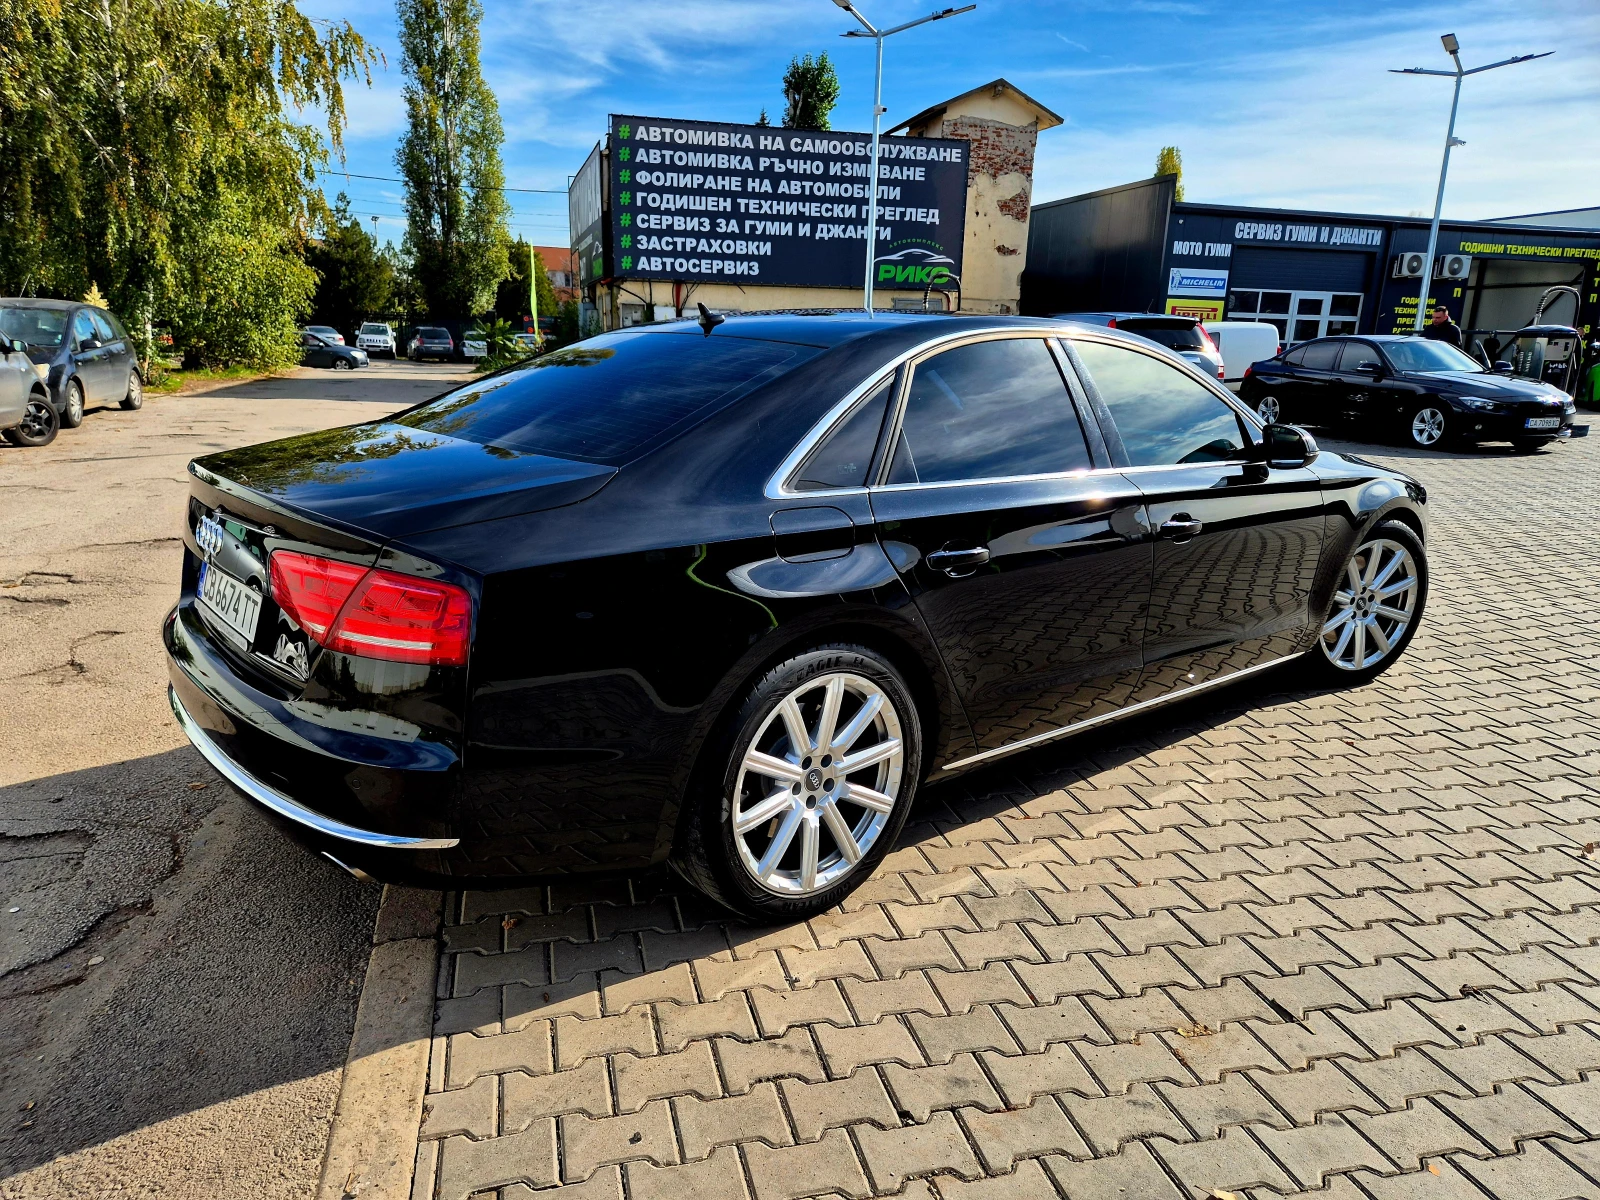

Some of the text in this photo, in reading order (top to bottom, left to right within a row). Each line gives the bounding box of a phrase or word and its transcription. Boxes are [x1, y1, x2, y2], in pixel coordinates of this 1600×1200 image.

[635, 125, 754, 149] АВТОМИВКА
[759, 135, 785, 151] НА
[635, 148, 754, 171] АВТОМИВКА
[759, 158, 825, 175] РЪЧНО
[635, 171, 742, 192] ФОЛИРАНЕ
[747, 178, 773, 194] НА
[636, 192, 732, 212] ГОДИШЕН
[737, 199, 857, 219] ТЕХНИЧЕСКИ
[636, 213, 711, 232] СЕРВИЗ
[716, 218, 740, 234] ЗА
[744, 219, 793, 237] ГУМИ
[798, 222, 811, 237] И
[1234, 221, 1383, 246] СЕРВИЗ ГУМИ И ДЖАНТИ
[636, 235, 772, 256] ЗАСТРАХОВКИ
[1173, 241, 1232, 258] МОТО ГУМИ
[1460, 241, 1505, 254] ГОДИШНИ
[1506, 245, 1562, 257] ТЕХНИЧЕСКИ
[637, 256, 760, 276] АВТОСЕРВИЗ
[877, 264, 950, 284] РИКО
[1181, 278, 1225, 287] MICHELIN
[1400, 296, 1436, 305] ГОДИНИ
[203, 565, 217, 602] CB
[215, 575, 243, 623] 6674
[241, 592, 259, 634] TT
[796, 656, 843, 681] EAGLE
